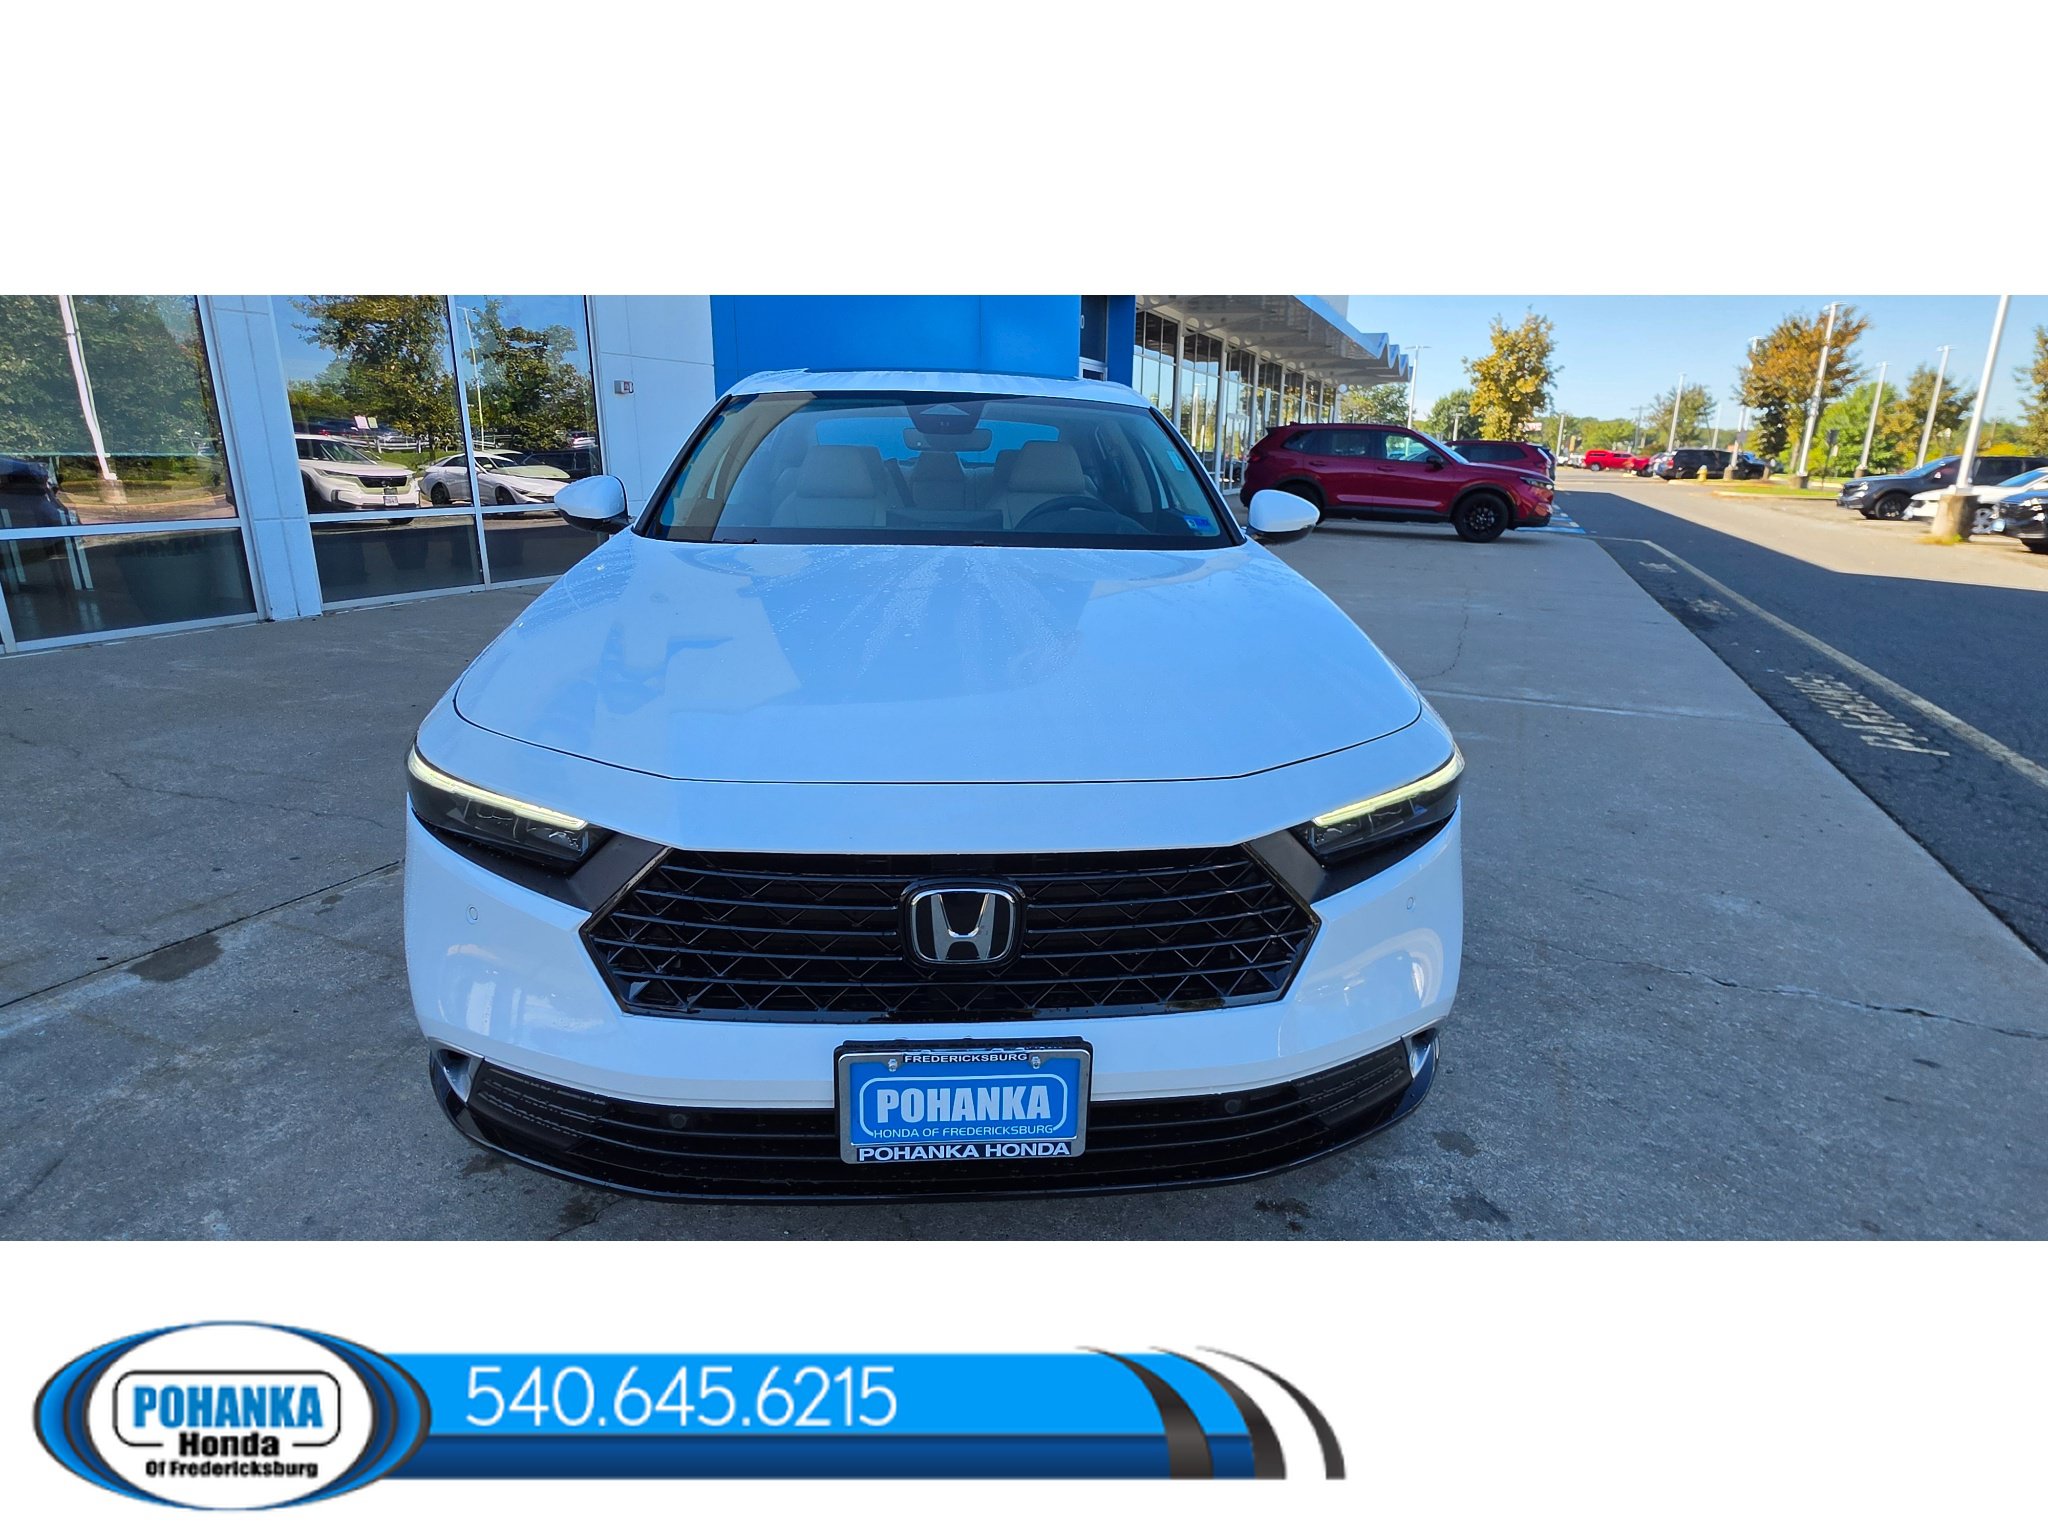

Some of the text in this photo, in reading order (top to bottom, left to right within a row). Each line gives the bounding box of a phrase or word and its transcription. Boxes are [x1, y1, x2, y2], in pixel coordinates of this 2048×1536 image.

[904, 1053, 1028, 1064] FREDERICKSBURG
[876, 1085, 1051, 1124] POHANKA
[874, 1124, 1054, 1139] HONDA OF FREDERICKSBURG
[859, 1142, 1070, 1161] POHANKA HONDA
